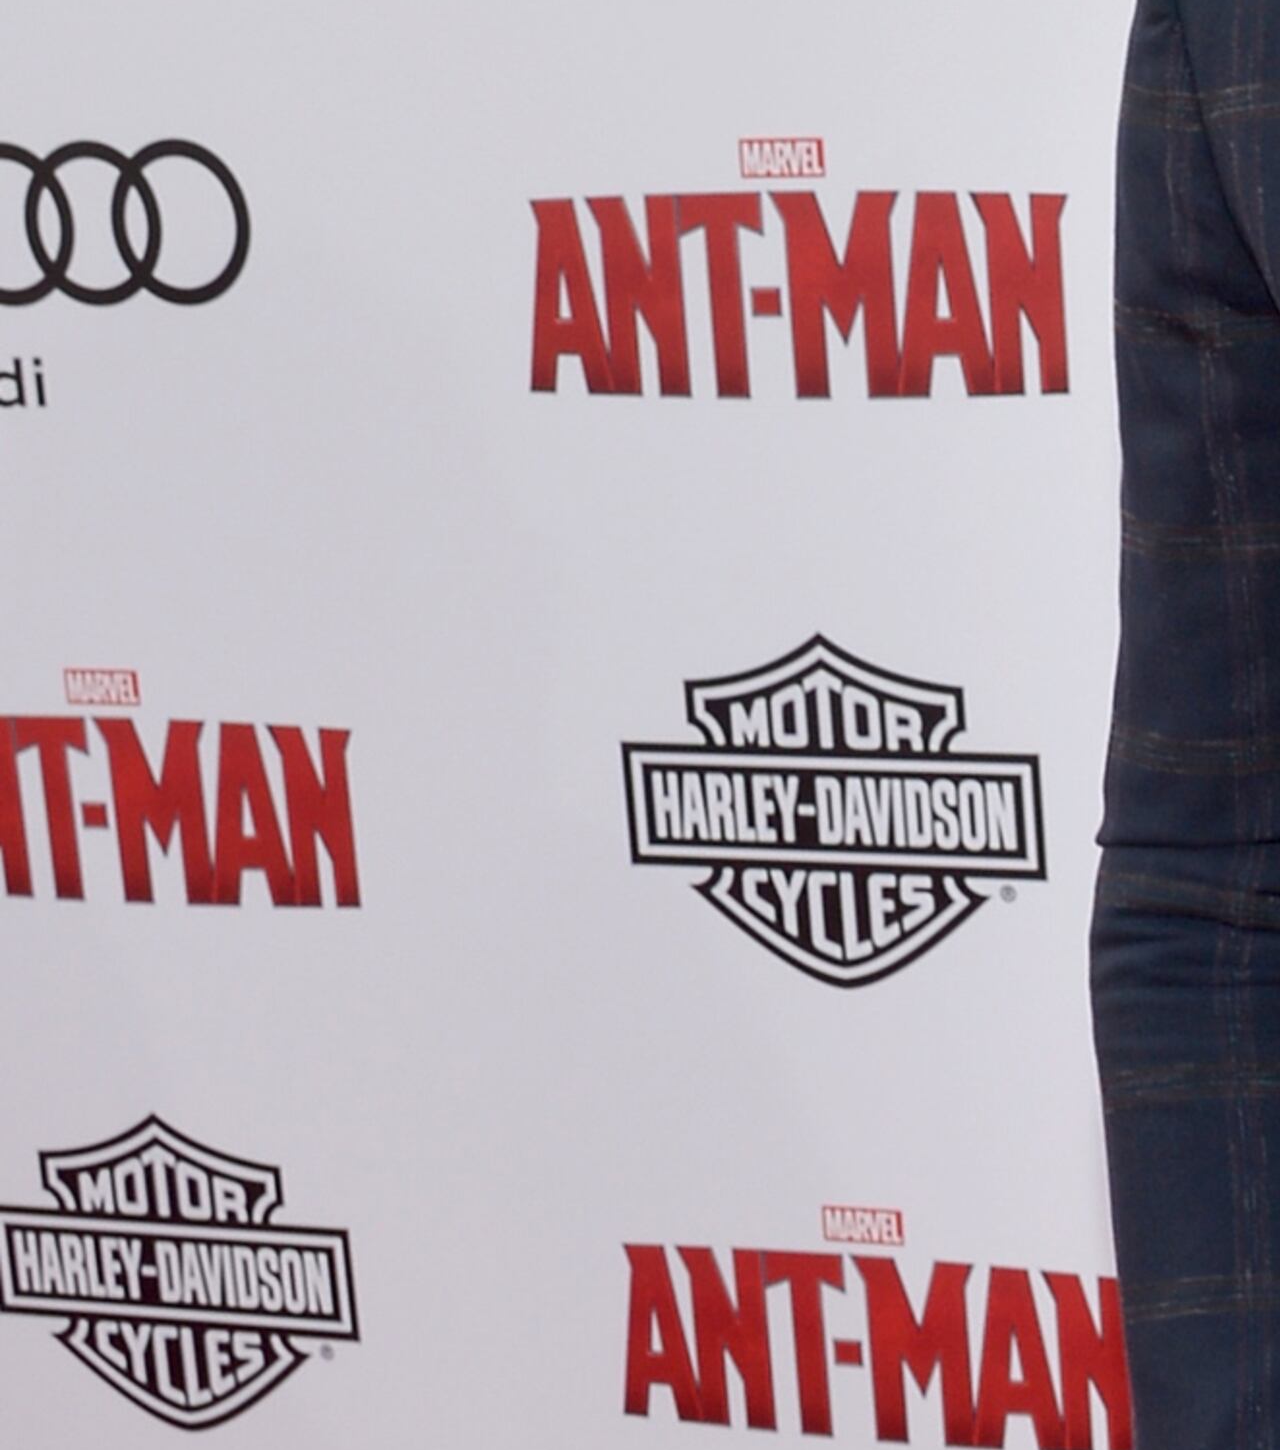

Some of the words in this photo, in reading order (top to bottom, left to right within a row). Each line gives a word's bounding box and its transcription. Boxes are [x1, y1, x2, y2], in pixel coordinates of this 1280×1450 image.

[739, 136, 826, 179] MARVEL
[529, 189, 1070, 400] ANT-MAN
[728, 667, 924, 753] MOTOR
[650, 770, 1019, 852] HARLEY-DAVIDSON
[740, 867, 936, 961] CYCLES
[77, 1147, 250, 1225] MOTOR
[822, 1205, 905, 1245] MARVEL
[11, 1229, 335, 1316] HARLEY-DAVIDSON
[94, 1320, 266, 1407] CYCLES
